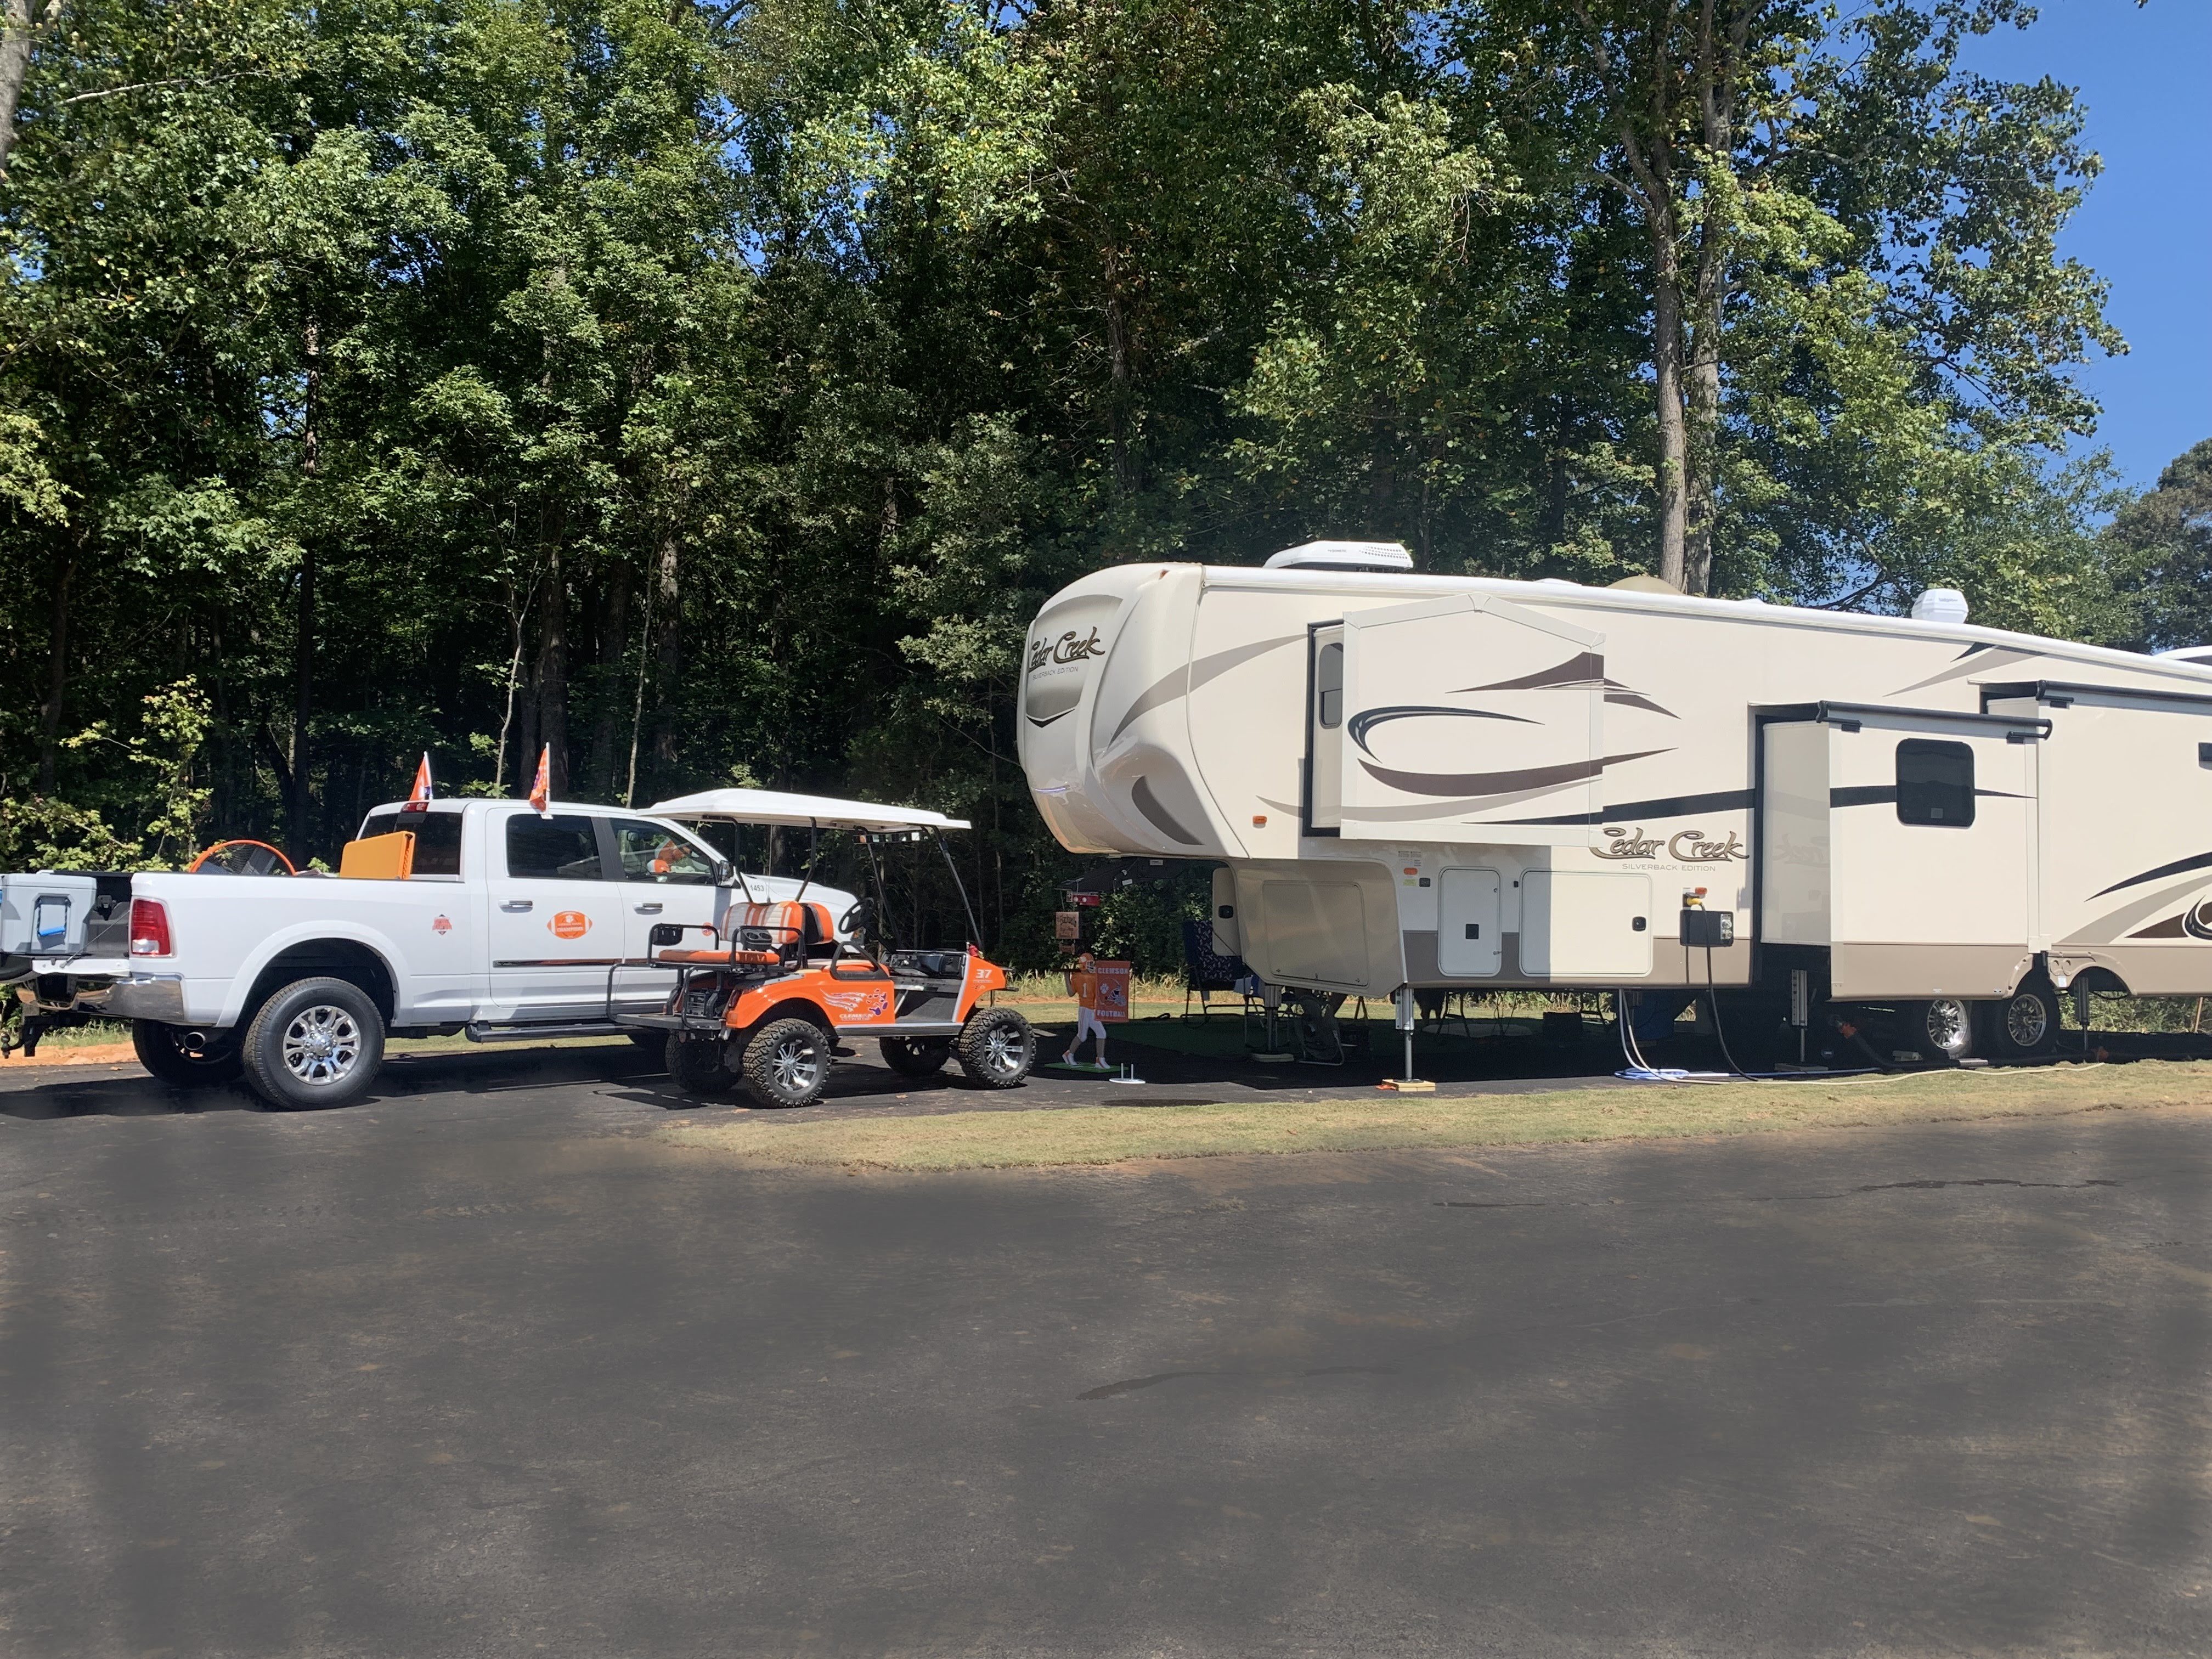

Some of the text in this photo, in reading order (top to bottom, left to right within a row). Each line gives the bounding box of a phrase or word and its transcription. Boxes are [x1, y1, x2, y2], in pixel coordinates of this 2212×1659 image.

[1053, 626, 1105, 664] Creek
[1032, 670, 1056, 680] SILVERBACK
[1589, 827, 1666, 860] Cedar
[1668, 830, 1750, 862] Creek
[975, 969, 992, 979] 37
[1083, 983, 1087, 998] 1
